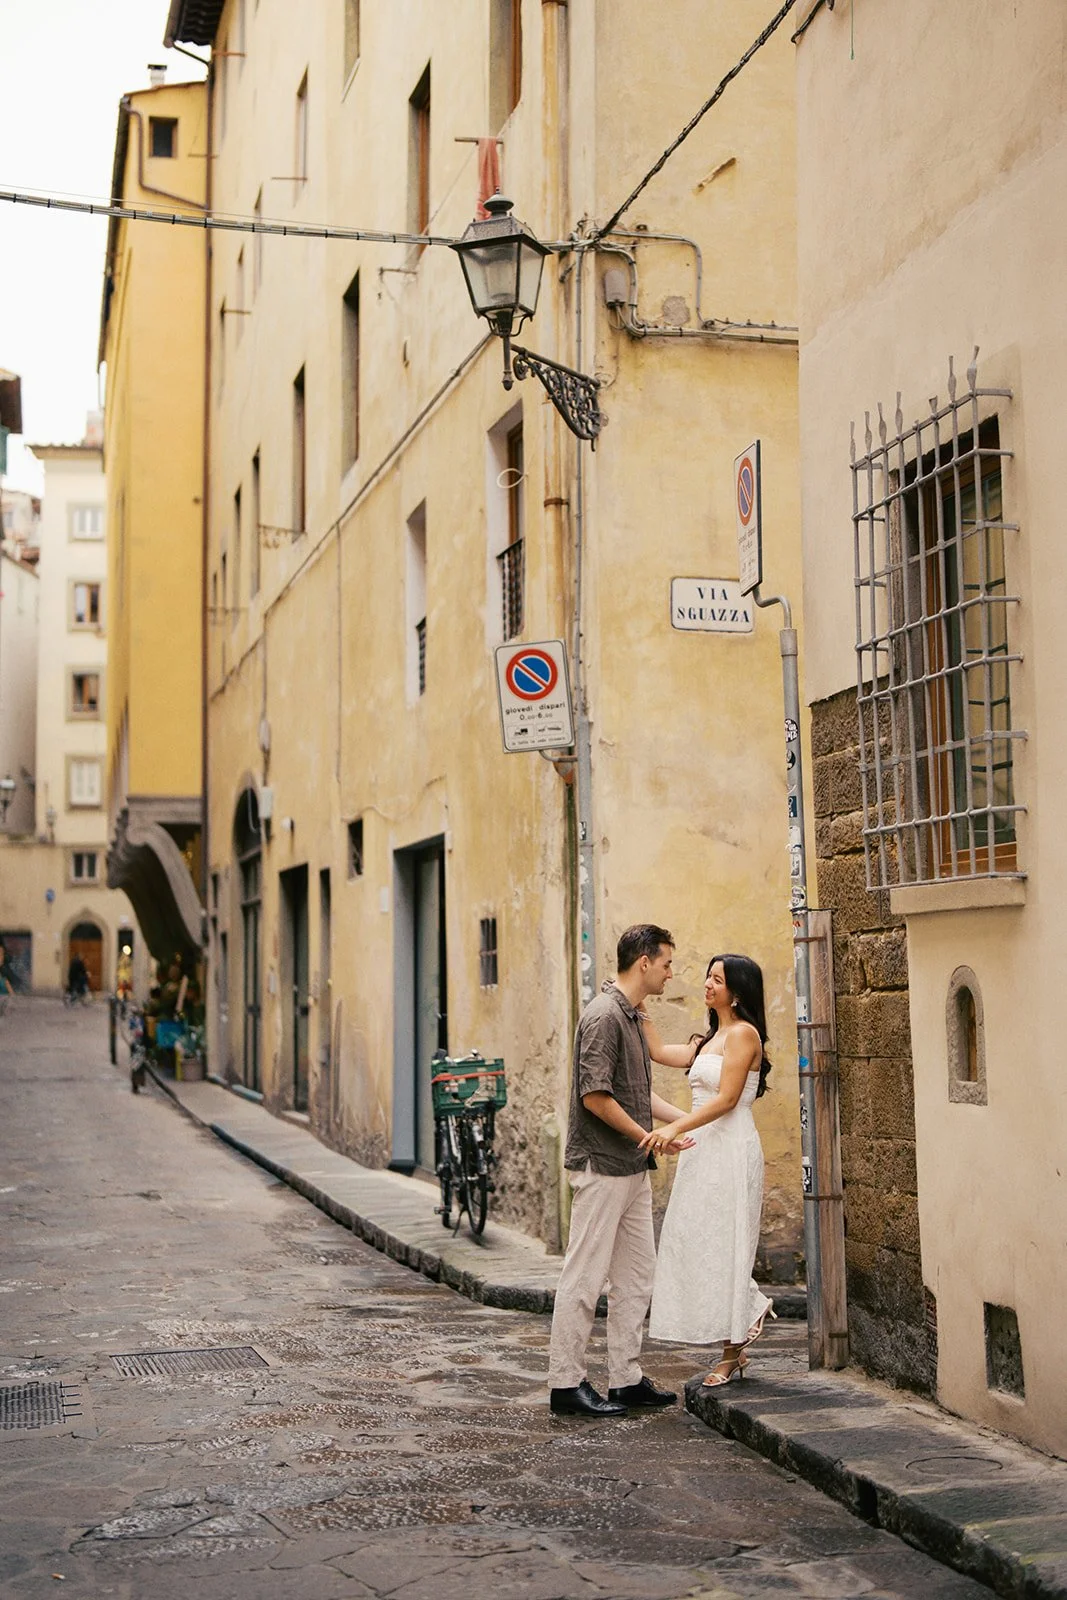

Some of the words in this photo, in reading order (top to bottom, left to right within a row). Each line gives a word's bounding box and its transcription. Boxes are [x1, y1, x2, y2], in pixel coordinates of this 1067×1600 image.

[697, 587, 728, 600] VIA
[677, 607, 750, 622] SGUAZZA
[539, 702, 566, 710] dispari
